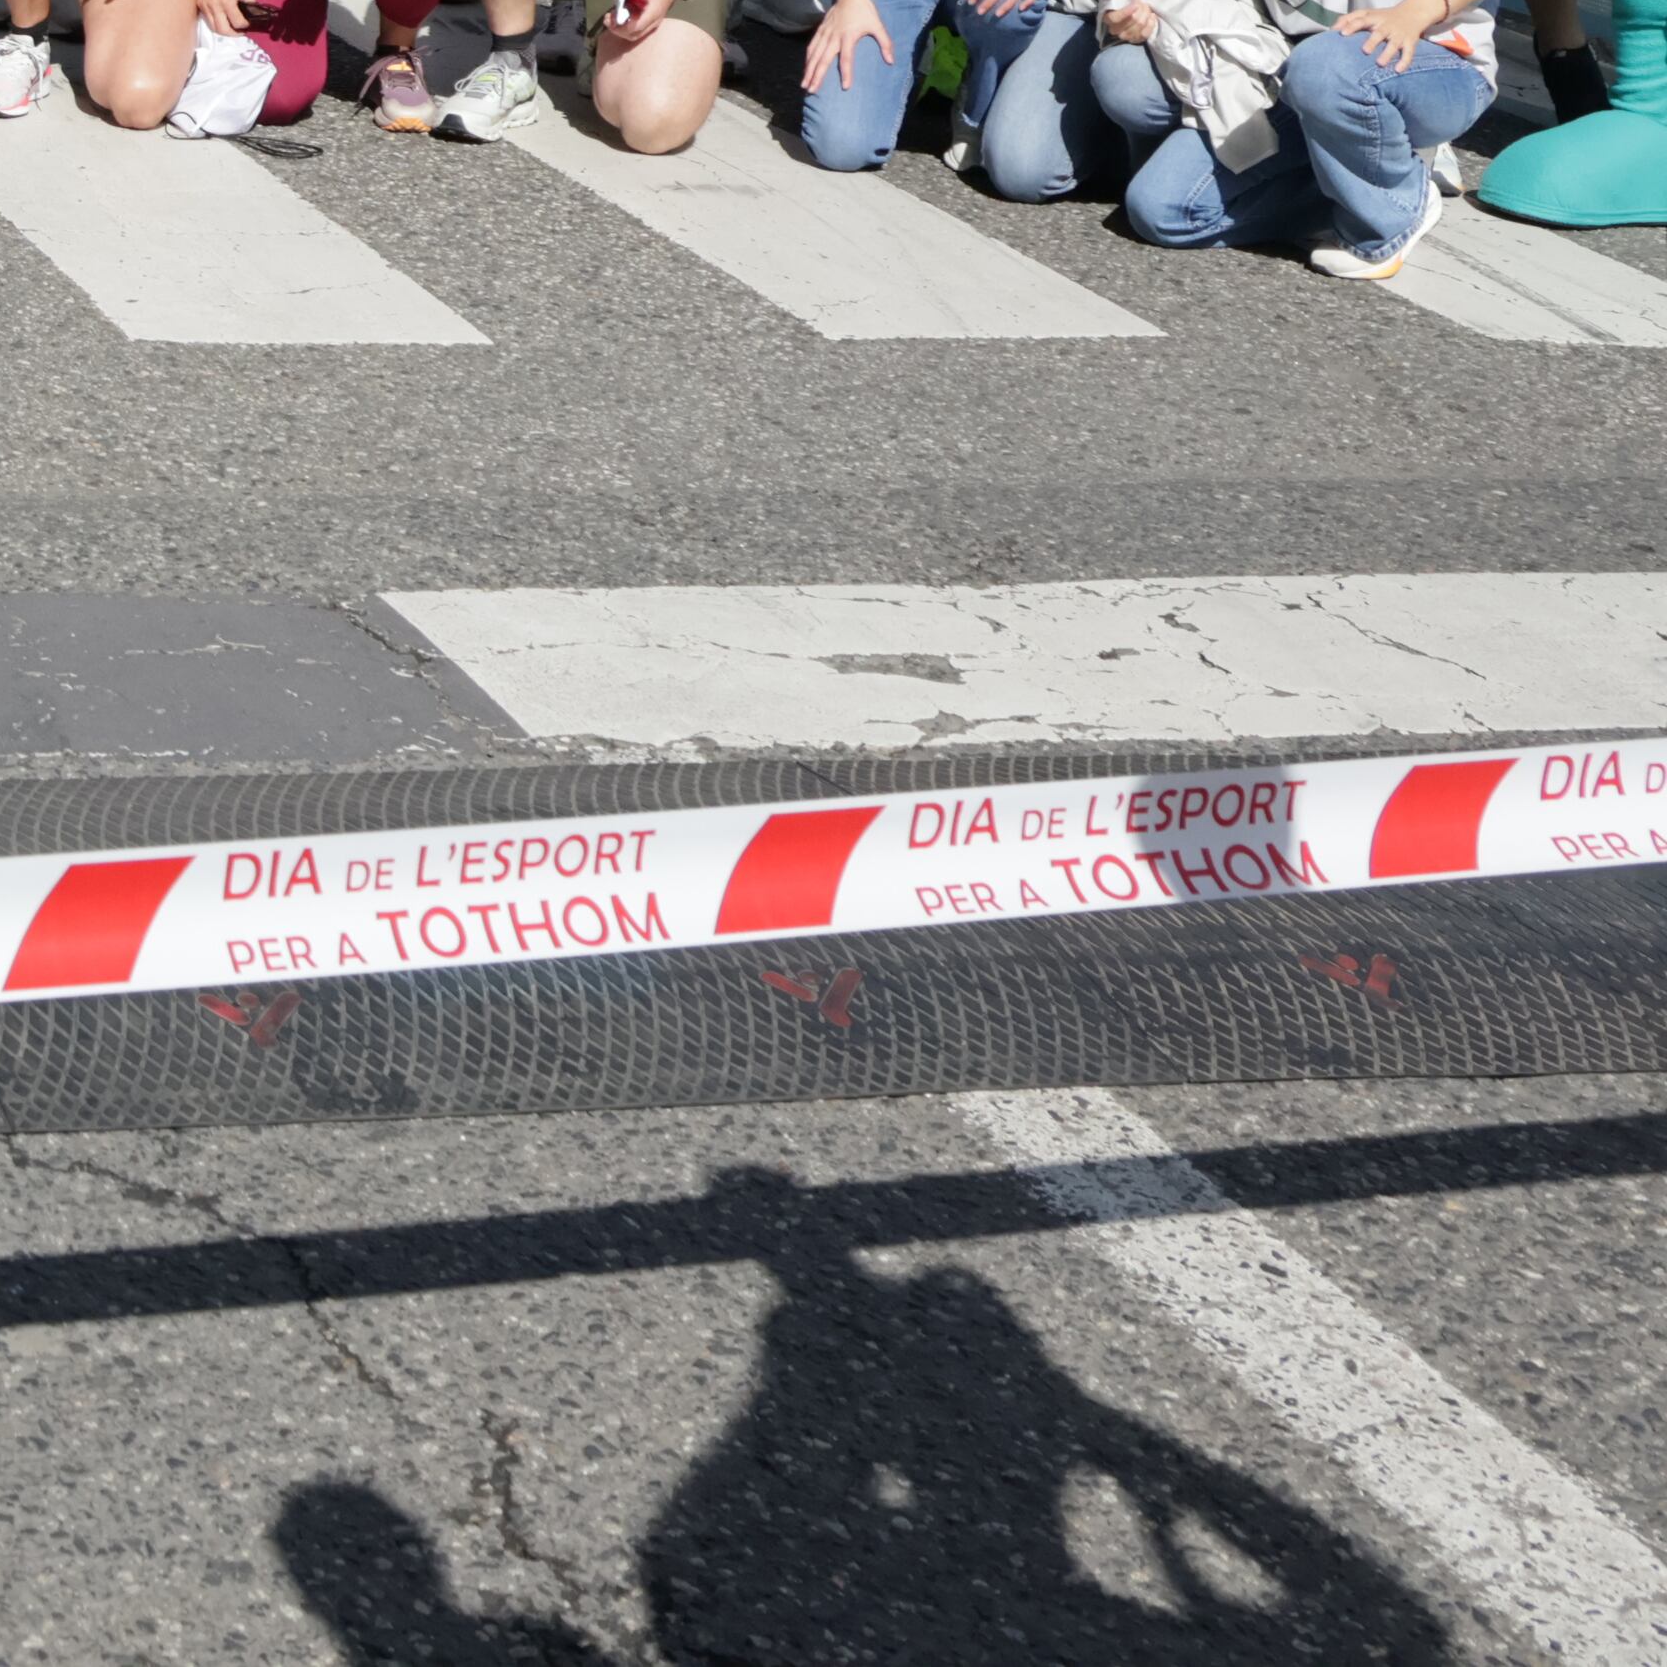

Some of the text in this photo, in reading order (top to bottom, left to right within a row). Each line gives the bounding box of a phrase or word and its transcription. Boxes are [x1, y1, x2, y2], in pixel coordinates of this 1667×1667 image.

[1539, 750, 1626, 802] DIA
[909, 781, 1306, 849] DIA DE L'ESPORT
[1553, 831, 1635, 863] PER
[223, 830, 654, 901] DIA DE L'ESPORT
[917, 837, 1328, 915] PER A TOTHOM
[228, 888, 670, 972] PER A TOTHOM
